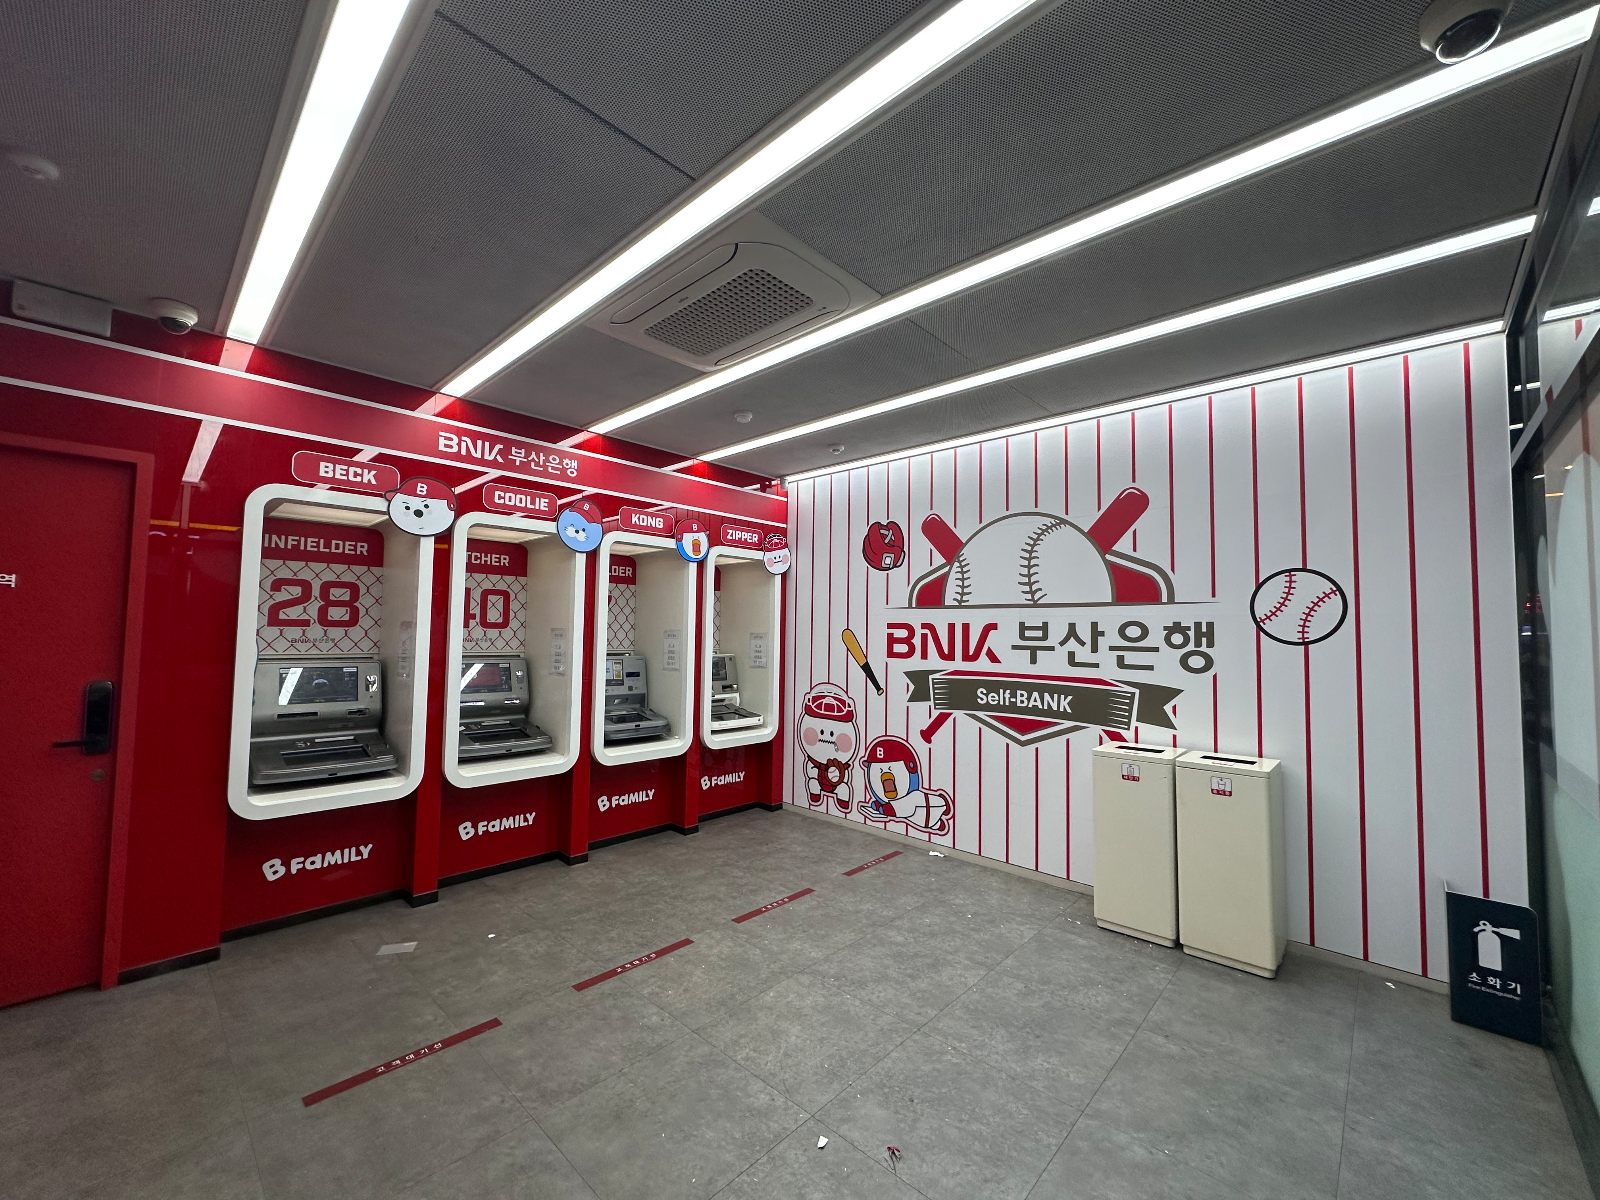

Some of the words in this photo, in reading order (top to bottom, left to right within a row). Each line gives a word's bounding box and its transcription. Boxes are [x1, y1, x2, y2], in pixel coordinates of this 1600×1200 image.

[438, 431, 504, 463] BNK
[508, 447, 578, 477] 부산은행
[319, 461, 377, 485] BECK
[416, 482, 428, 495] B
[494, 490, 549, 511] COOLIE
[631, 513, 664, 529] KONG
[692, 523, 698, 531] B
[264, 533, 369, 556] INFIELDER
[726, 529, 759, 544] ZIPPER
[609, 565, 633, 578] DER
[266, 577, 361, 628] 28
[886, 622, 1002, 664] BNK
[1011, 620, 1216, 674] 부산은행
[976, 687, 1074, 713] Self-BANK
[876, 746, 884, 759] B
[701, 775, 711, 791] B
[597, 795, 610, 812] B
[458, 821, 475, 841] B
[262, 858, 286, 882] B
[1468, 972, 1521, 995] 소화기
